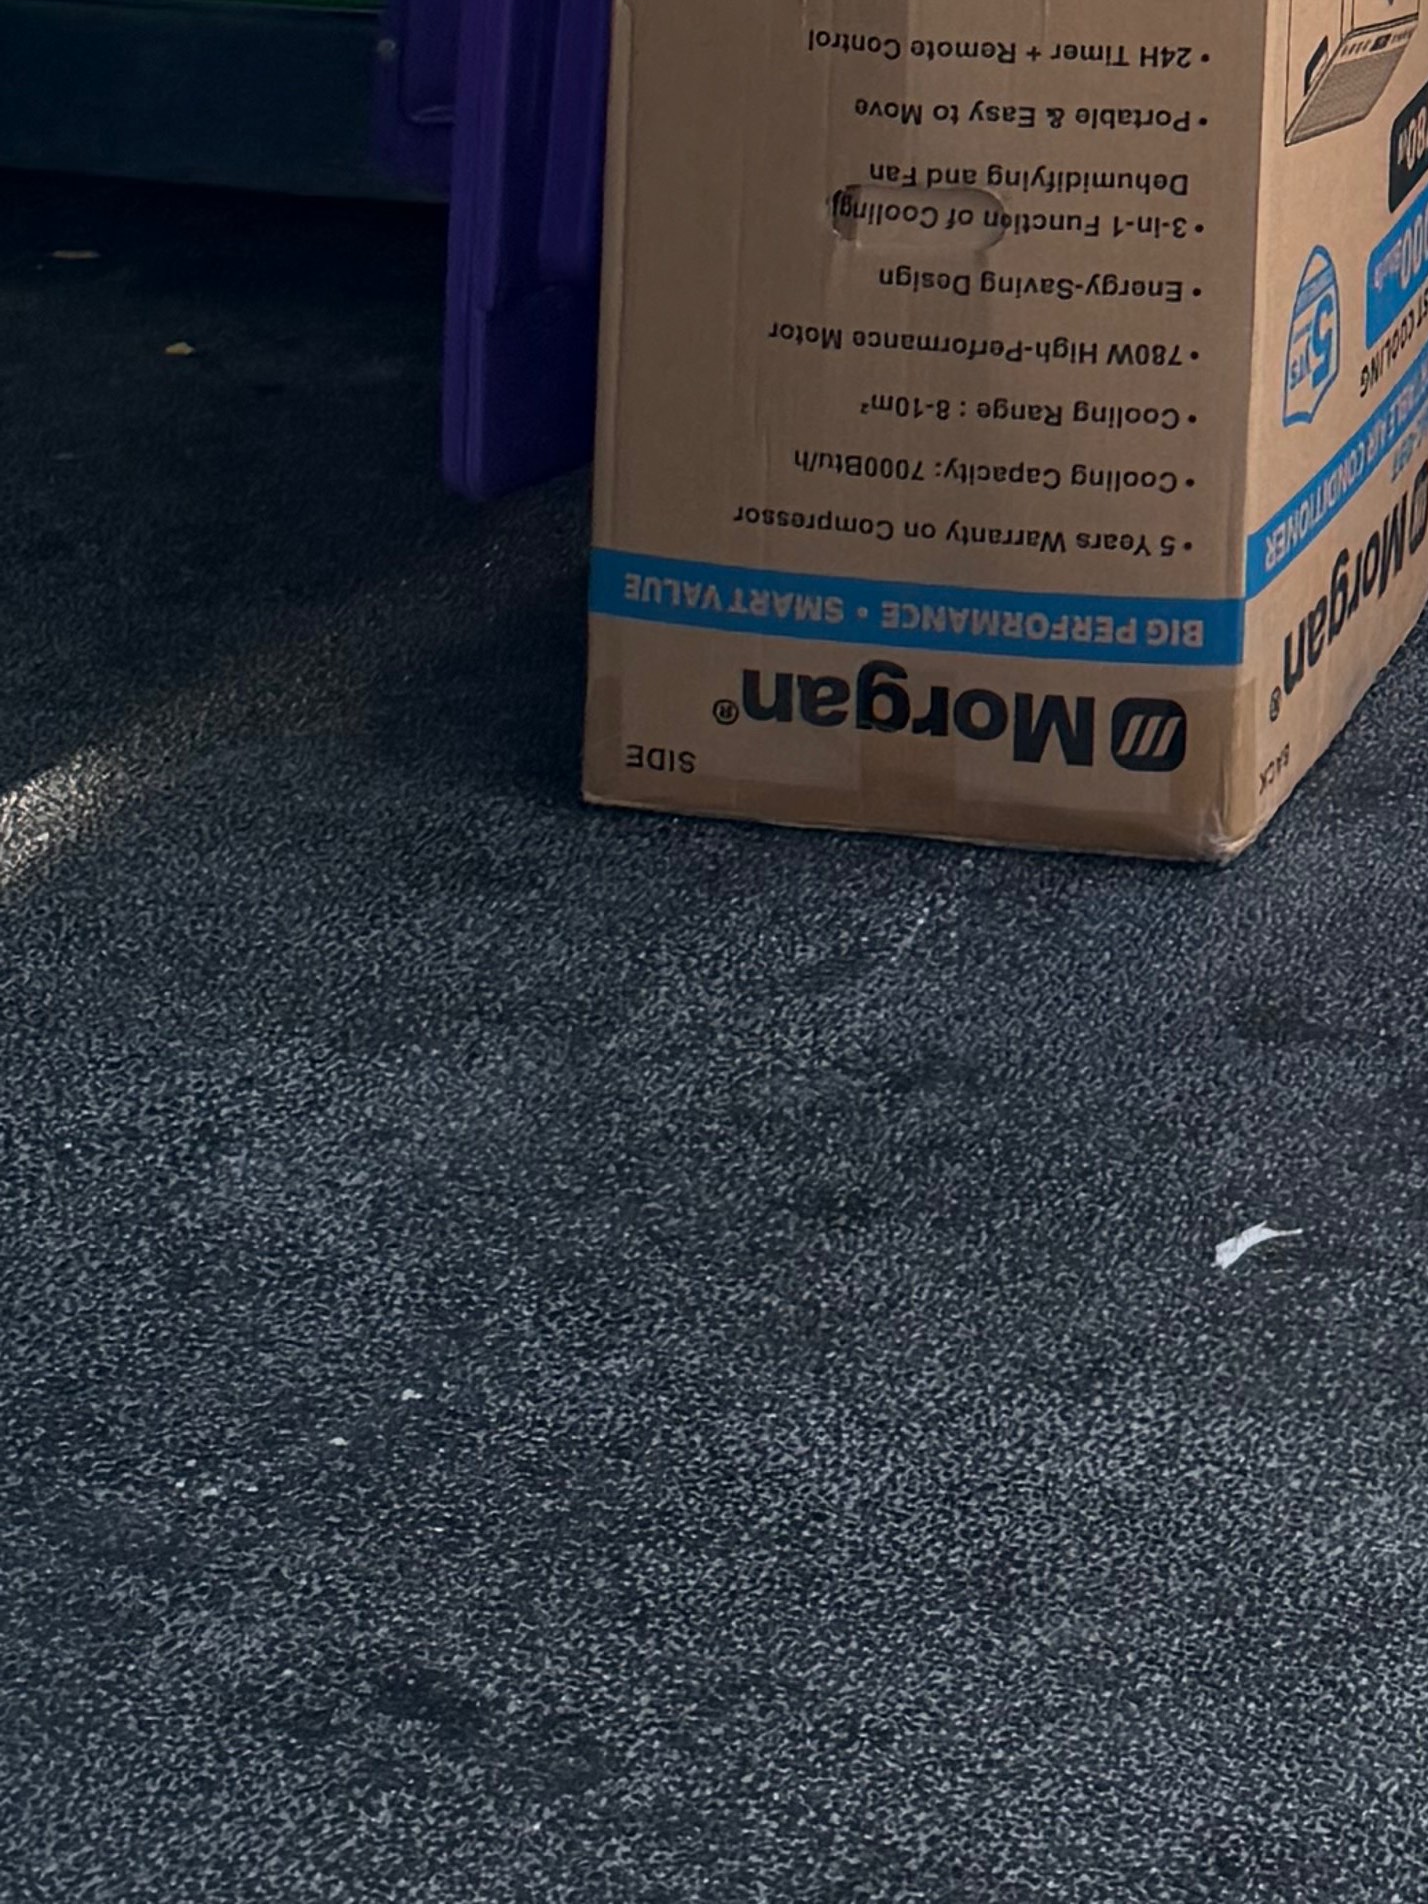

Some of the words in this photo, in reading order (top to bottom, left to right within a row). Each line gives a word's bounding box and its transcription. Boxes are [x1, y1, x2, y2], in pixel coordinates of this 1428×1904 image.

[809, 30, 900, 60] Control
[911, 40, 1015, 63] Remote
[1027, 46, 1041, 61] +
[1051, 44, 1129, 66] Timer
[1140, 47, 1191, 68] 24H
[855, 99, 922, 125] Move
[933, 105, 958, 124] to
[969, 100, 1035, 127] Easy
[1046, 108, 1064, 128] &
[1076, 108, 1190, 131] Portable
[870, 164, 917, 187] Fan
[927, 168, 976, 188] and
[988, 165, 1188, 195] Dehumidifying
[945, 209, 973, 229] of
[984, 211, 1099, 236] Function
[1114, 216, 1186, 238] 3-in-1
[880, 265, 970, 295] Design
[981, 271, 1182, 302] Energy-Saving
[769, 323, 842, 349] Motor
[853, 331, 1097, 364] High-Performance
[1107, 344, 1182, 365] 780W
[861, 395, 949, 420] 8-10m²
[977, 398, 1062, 426] Range
[1073, 401, 1179, 429] Cooling
[795, 450, 924, 481] 7000Btu/h
[936, 458, 1060, 489] Capacity:
[1072, 464, 1177, 493] Cooling
[734, 507, 893, 540] Compressor
[905, 522, 936, 538] on
[946, 520, 1066, 552] Warranty
[1076, 533, 1151, 556] Years
[1161, 536, 1175, 556] 5
[625, 573, 721, 610] VALUE
[729, 588, 844, 622] SMART
[882, 602, 1136, 643] PERFORMANCE
[1147, 620, 1203, 646] BIG
[627, 745, 695, 773] SIDE
